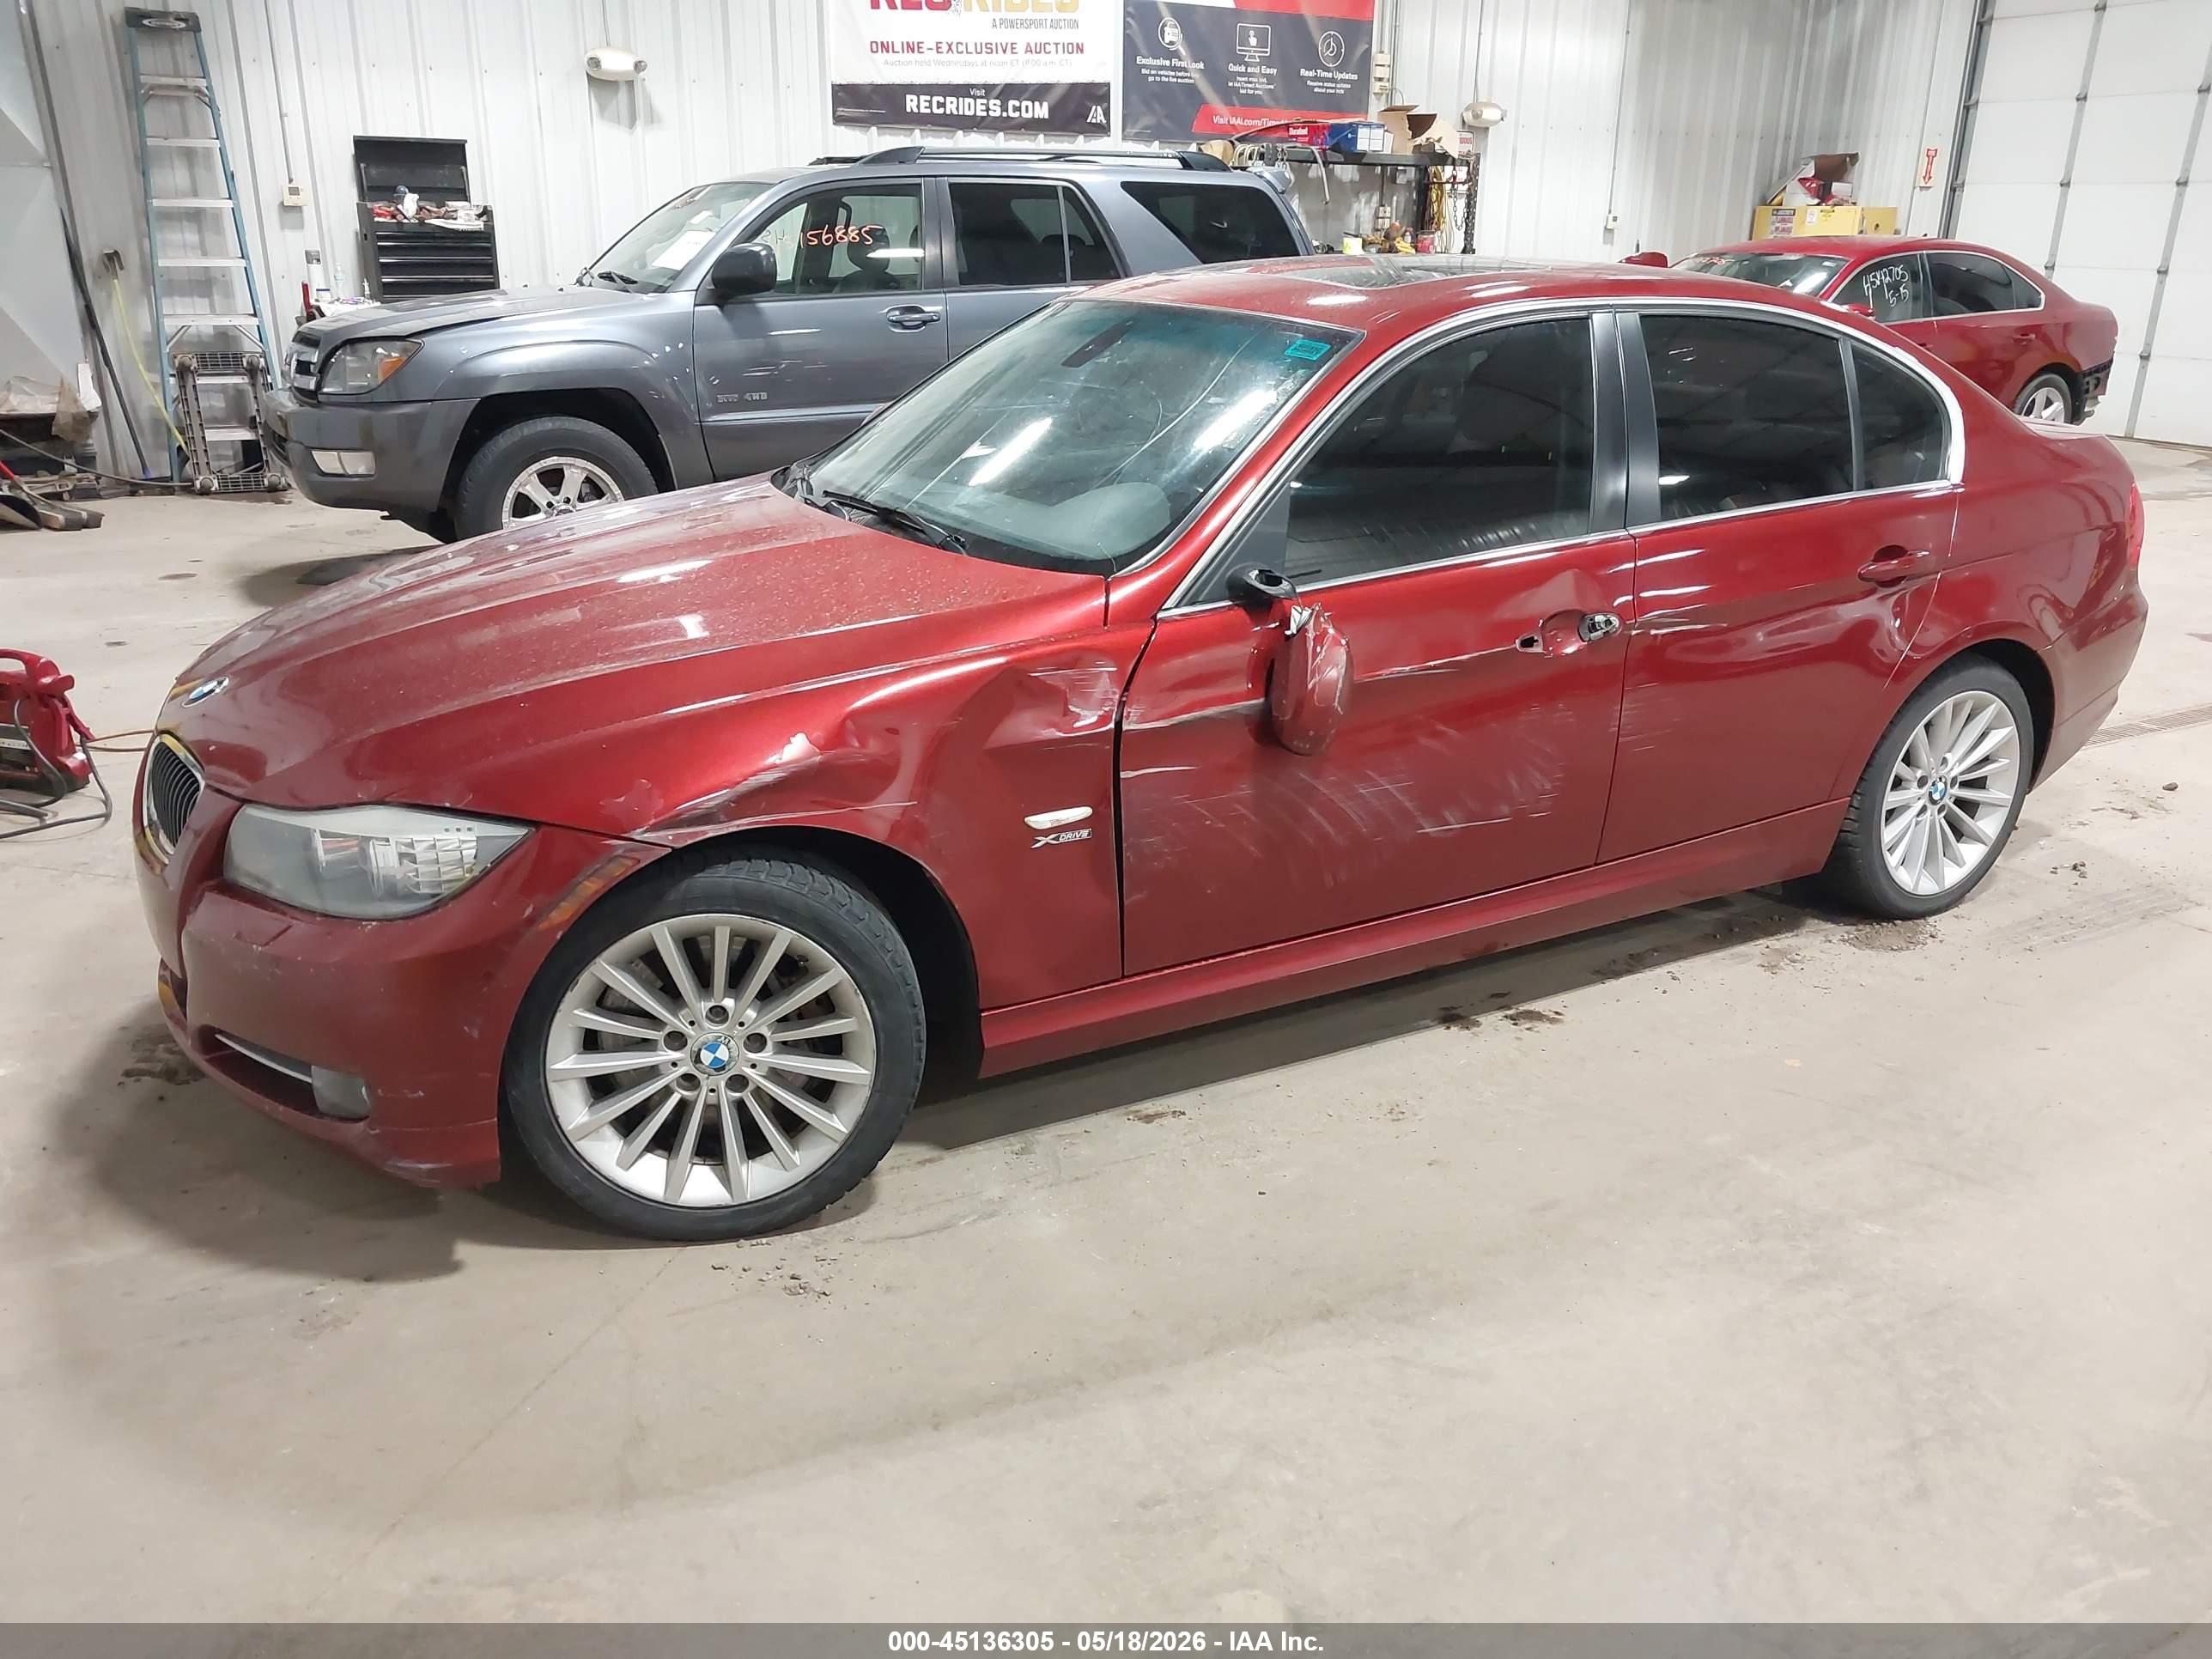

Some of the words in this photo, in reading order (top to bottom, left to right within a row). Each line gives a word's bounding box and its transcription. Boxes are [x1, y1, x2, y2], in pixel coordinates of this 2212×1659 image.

[1000, 18, 1048, 29] POWERSPORT
[1049, 19, 1079, 29] AUCTION
[870, 41, 1018, 55] ONLINE-EXCLUSIVE
[1024, 42, 1085, 55] AUCTION
[884, 58, 913, 67] Auction
[1136, 55, 1170, 67] Exclusive
[1171, 58, 1188, 68] First
[1228, 63, 1246, 73] Quick
[1261, 65, 1278, 76] Easy
[1299, 68, 1333, 78] Real-Time
[1333, 70, 1358, 81] Updates
[969, 88, 986, 97] Visit
[905, 94, 1049, 119] RECRIDES.COM
[1212, 114, 1229, 125] Visit
